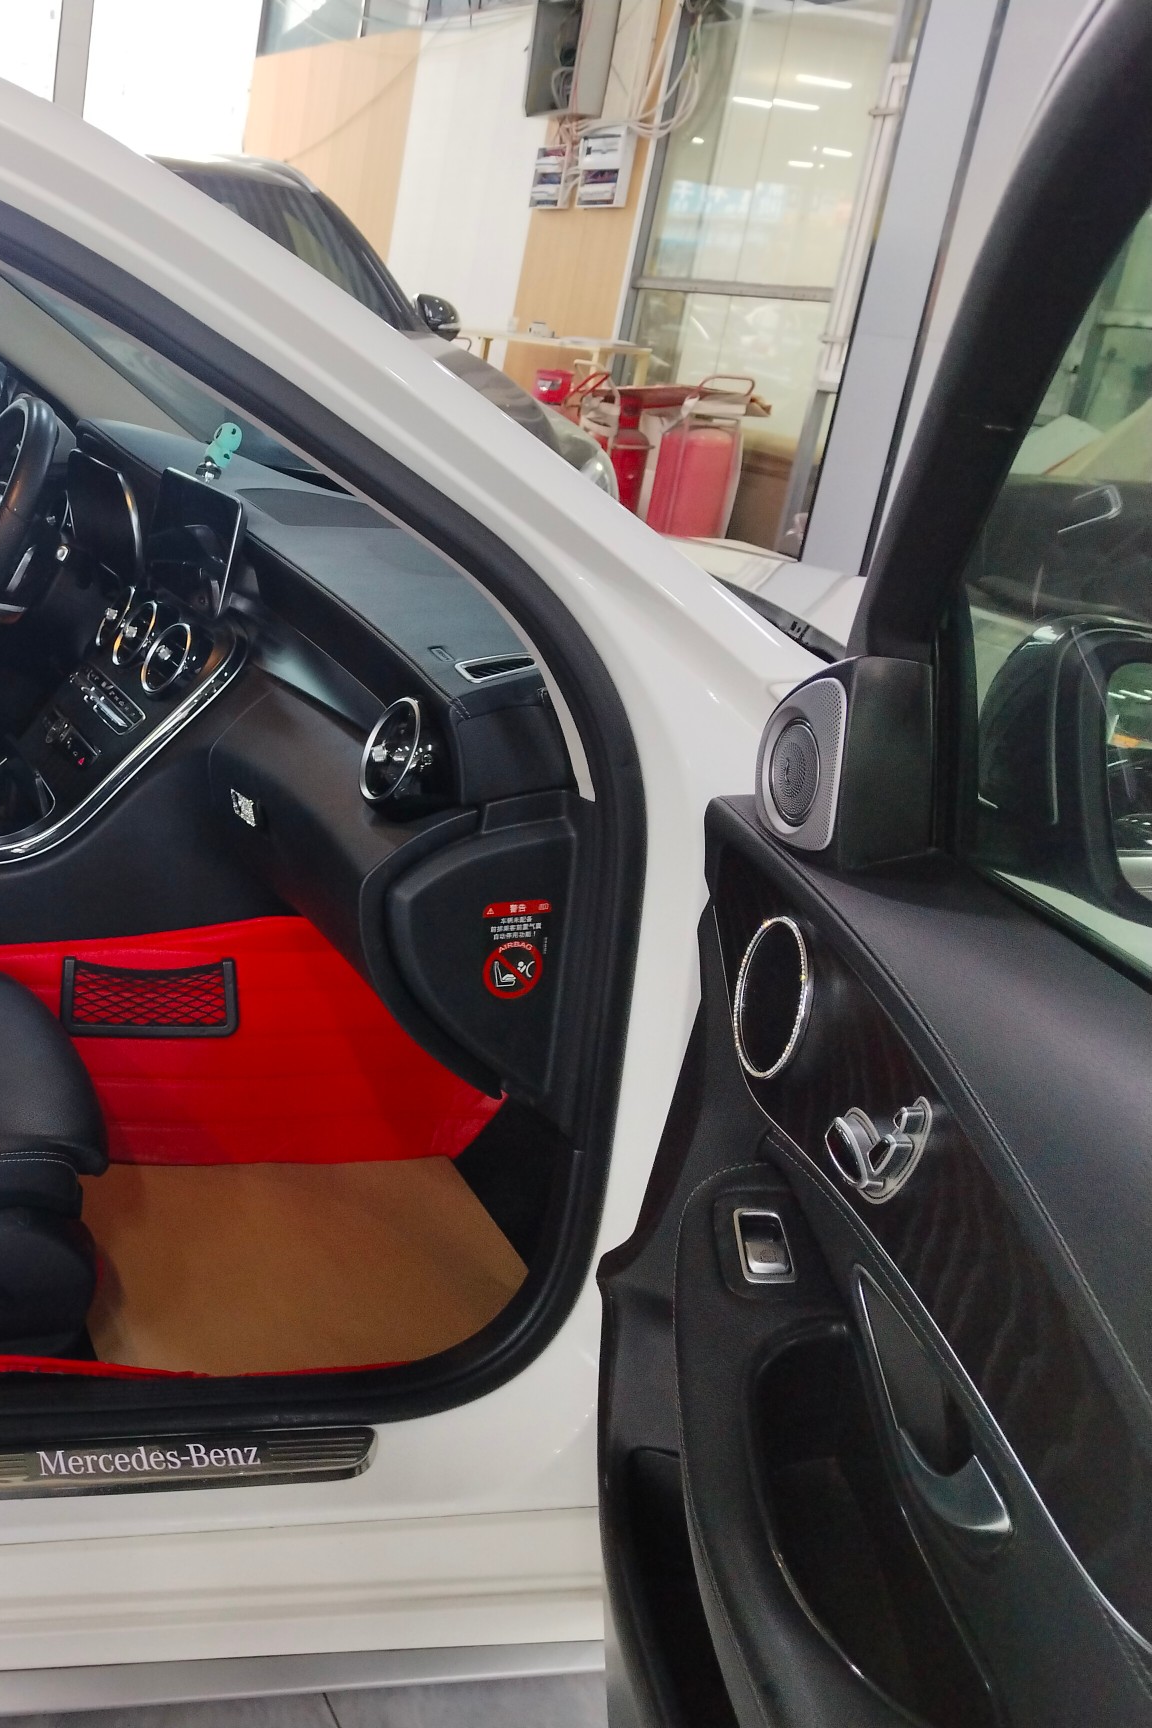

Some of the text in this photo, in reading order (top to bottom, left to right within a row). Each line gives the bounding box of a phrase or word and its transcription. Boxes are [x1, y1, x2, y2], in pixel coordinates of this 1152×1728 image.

[509, 904, 527, 913] 警告
[498, 941, 533, 953] AIRBAG
[37, 1443, 261, 1476] Mercedes-Benz
